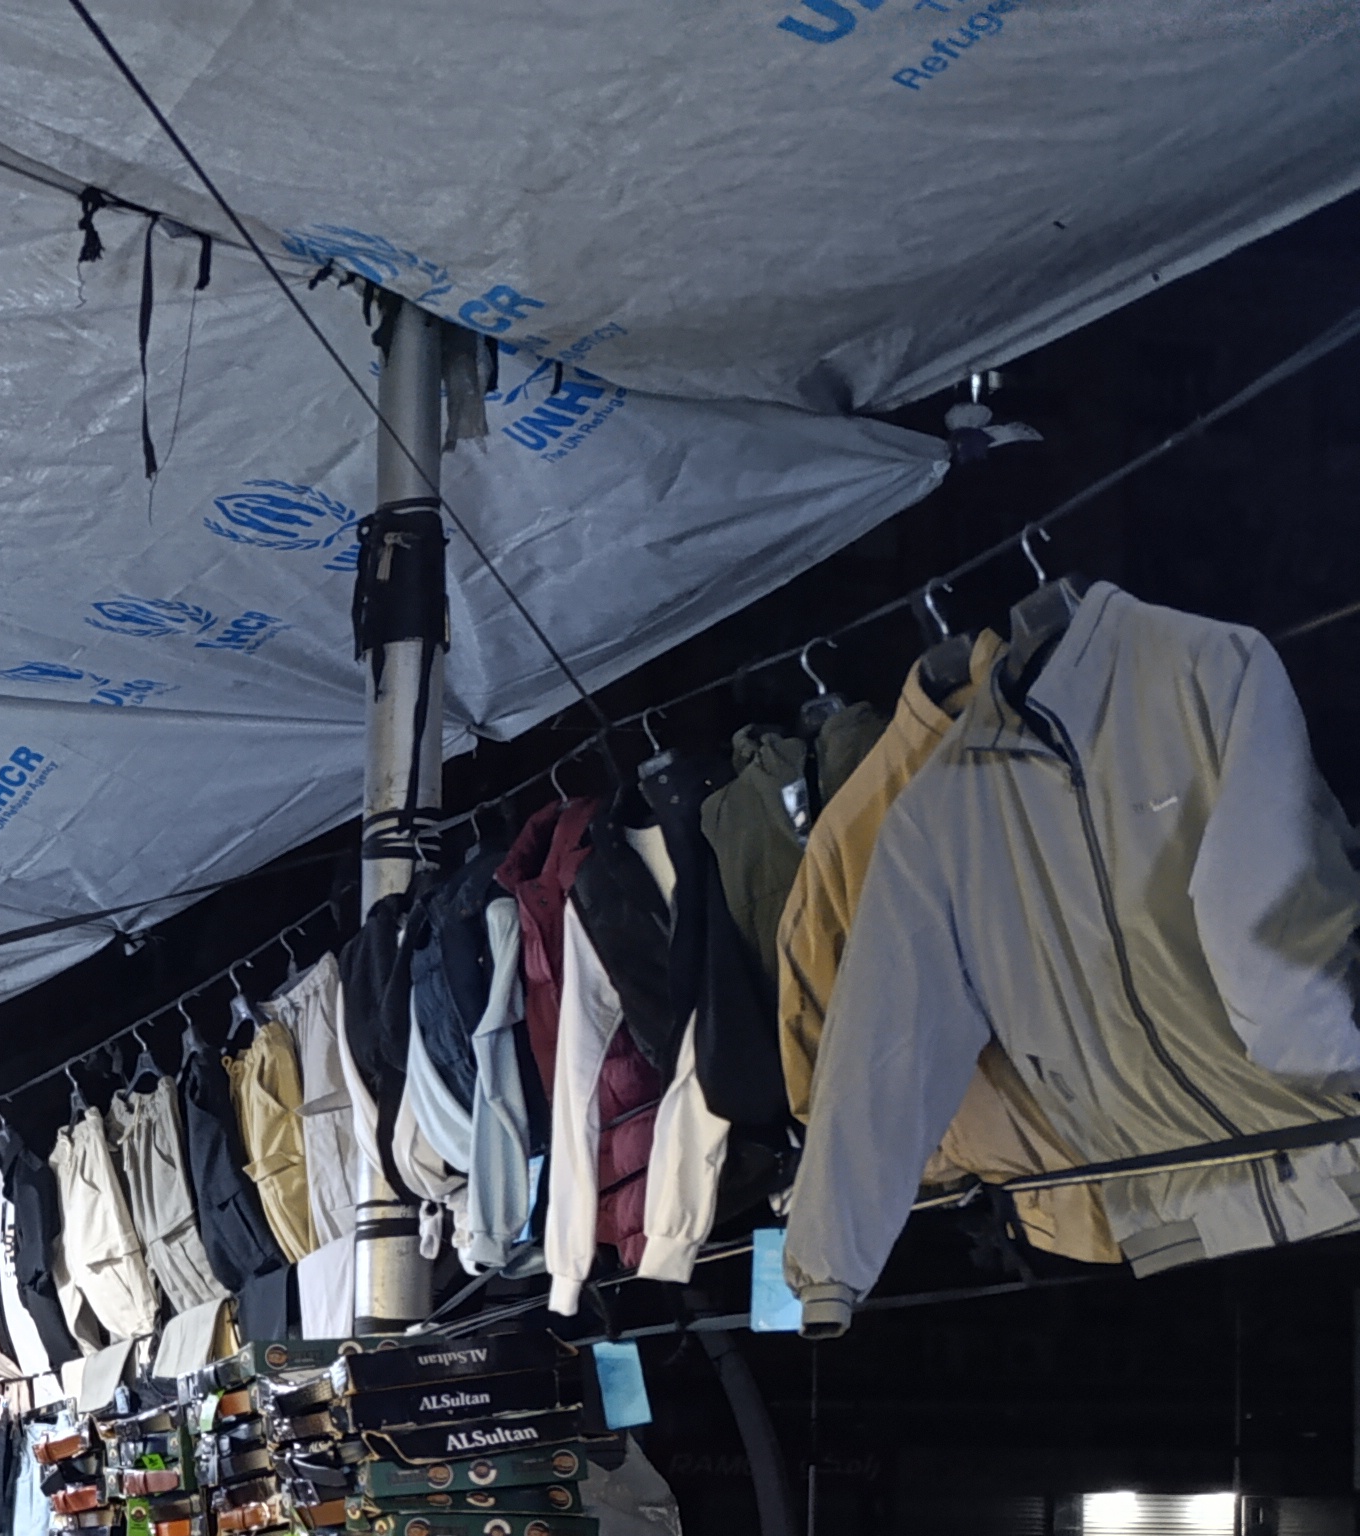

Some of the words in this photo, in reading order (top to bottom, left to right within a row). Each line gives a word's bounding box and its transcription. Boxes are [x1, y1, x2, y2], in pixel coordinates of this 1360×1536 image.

[30, 760, 59, 790] Agency
[418, 1348, 488, 1367] ALSultan
[419, 1391, 491, 1411] ALSultan
[446, 1425, 539, 1452] ALSultan
